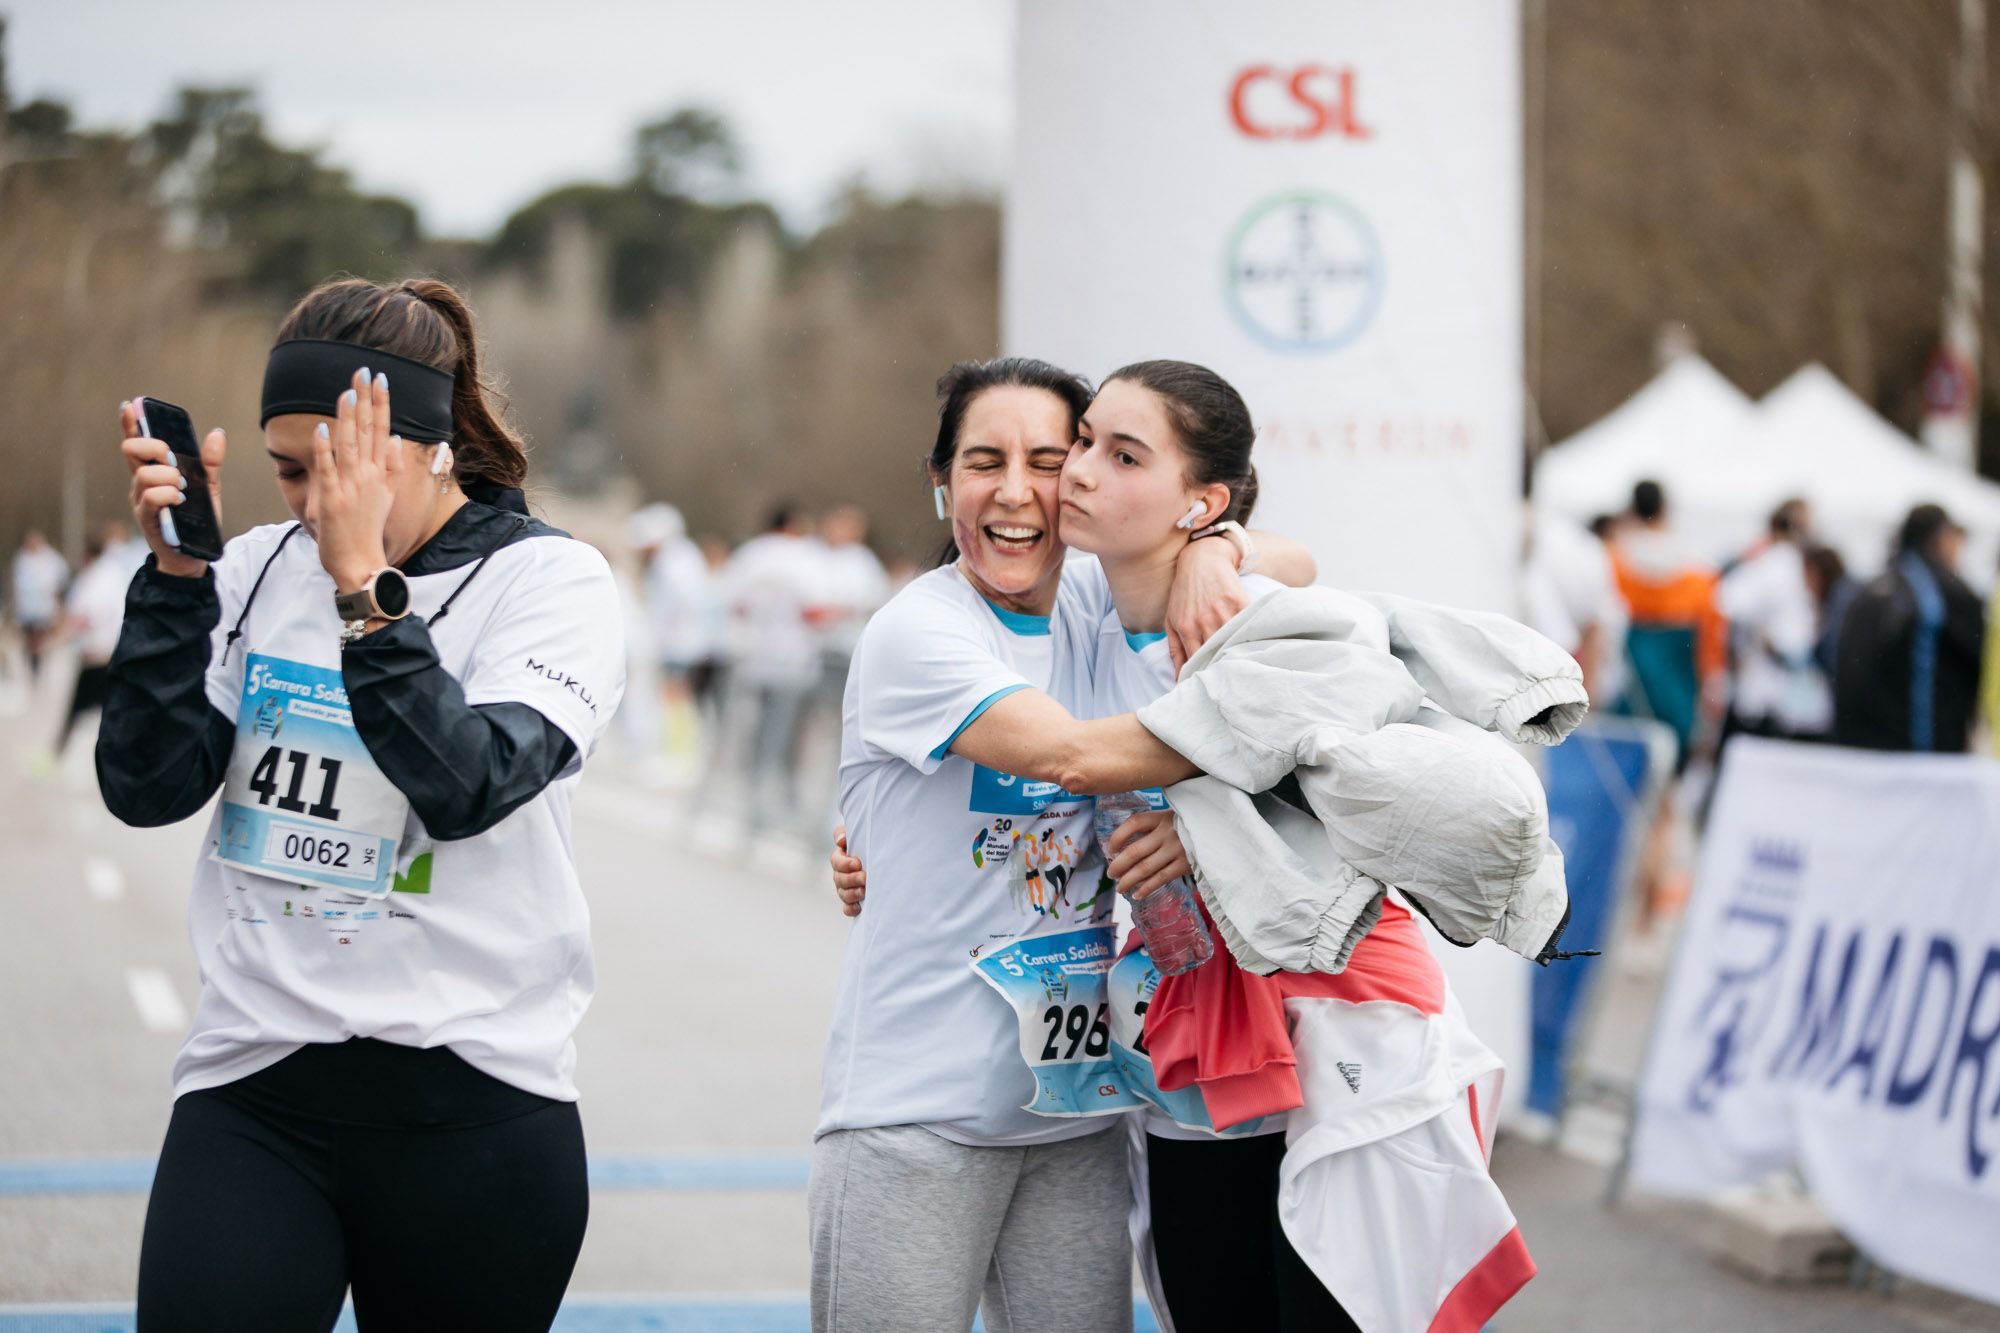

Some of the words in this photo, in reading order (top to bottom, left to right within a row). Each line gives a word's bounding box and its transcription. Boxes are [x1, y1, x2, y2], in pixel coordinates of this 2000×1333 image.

[1227, 64, 1375, 140] CSL
[262, 673, 312, 698] Carrera
[250, 745, 343, 822] 411
[996, 818, 1012, 831] 20
[284, 833, 351, 868] 0062
[363, 847, 376, 865] 5K
[1023, 953, 1068, 966] Carrera
[1041, 1003, 1111, 1061] 296
[1769, 922, 2000, 1178] MADR
[1098, 1084, 1119, 1096] CSL
